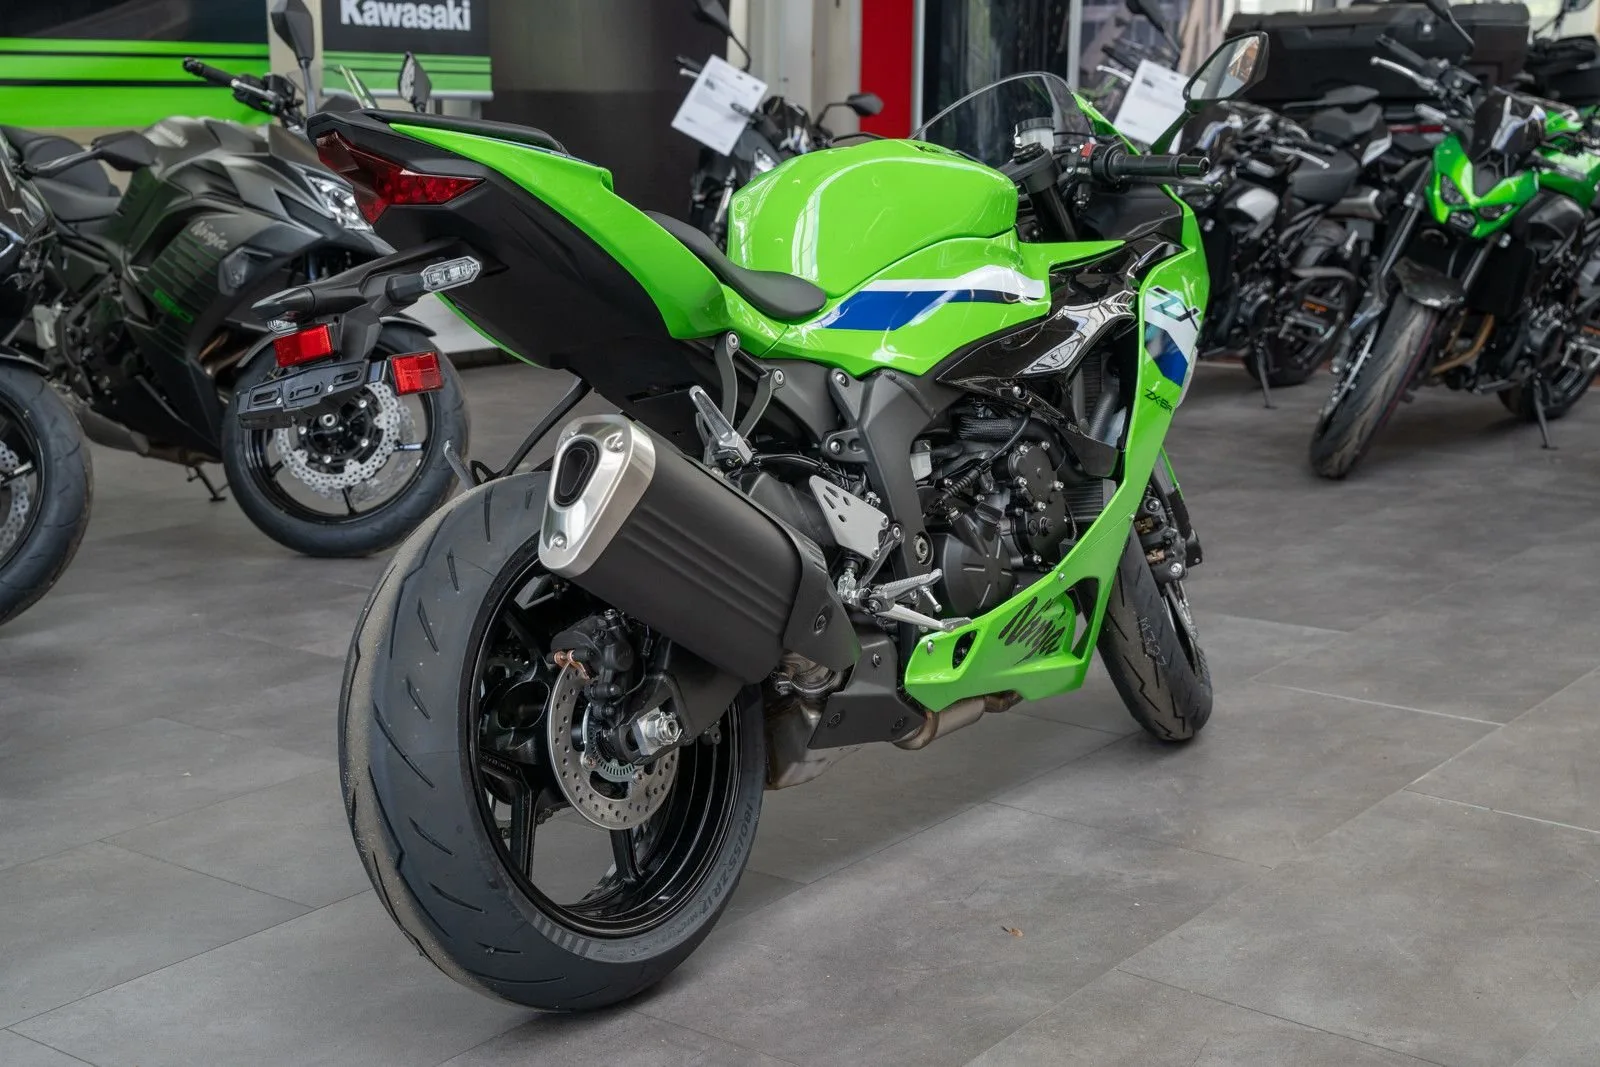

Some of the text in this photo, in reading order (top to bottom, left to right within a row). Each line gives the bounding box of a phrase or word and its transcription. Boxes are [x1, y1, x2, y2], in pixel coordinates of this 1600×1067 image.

[340, 0, 471, 31] Kawasaki
[190, 220, 229, 251] Ninja
[998, 596, 1066, 666] Ninja
